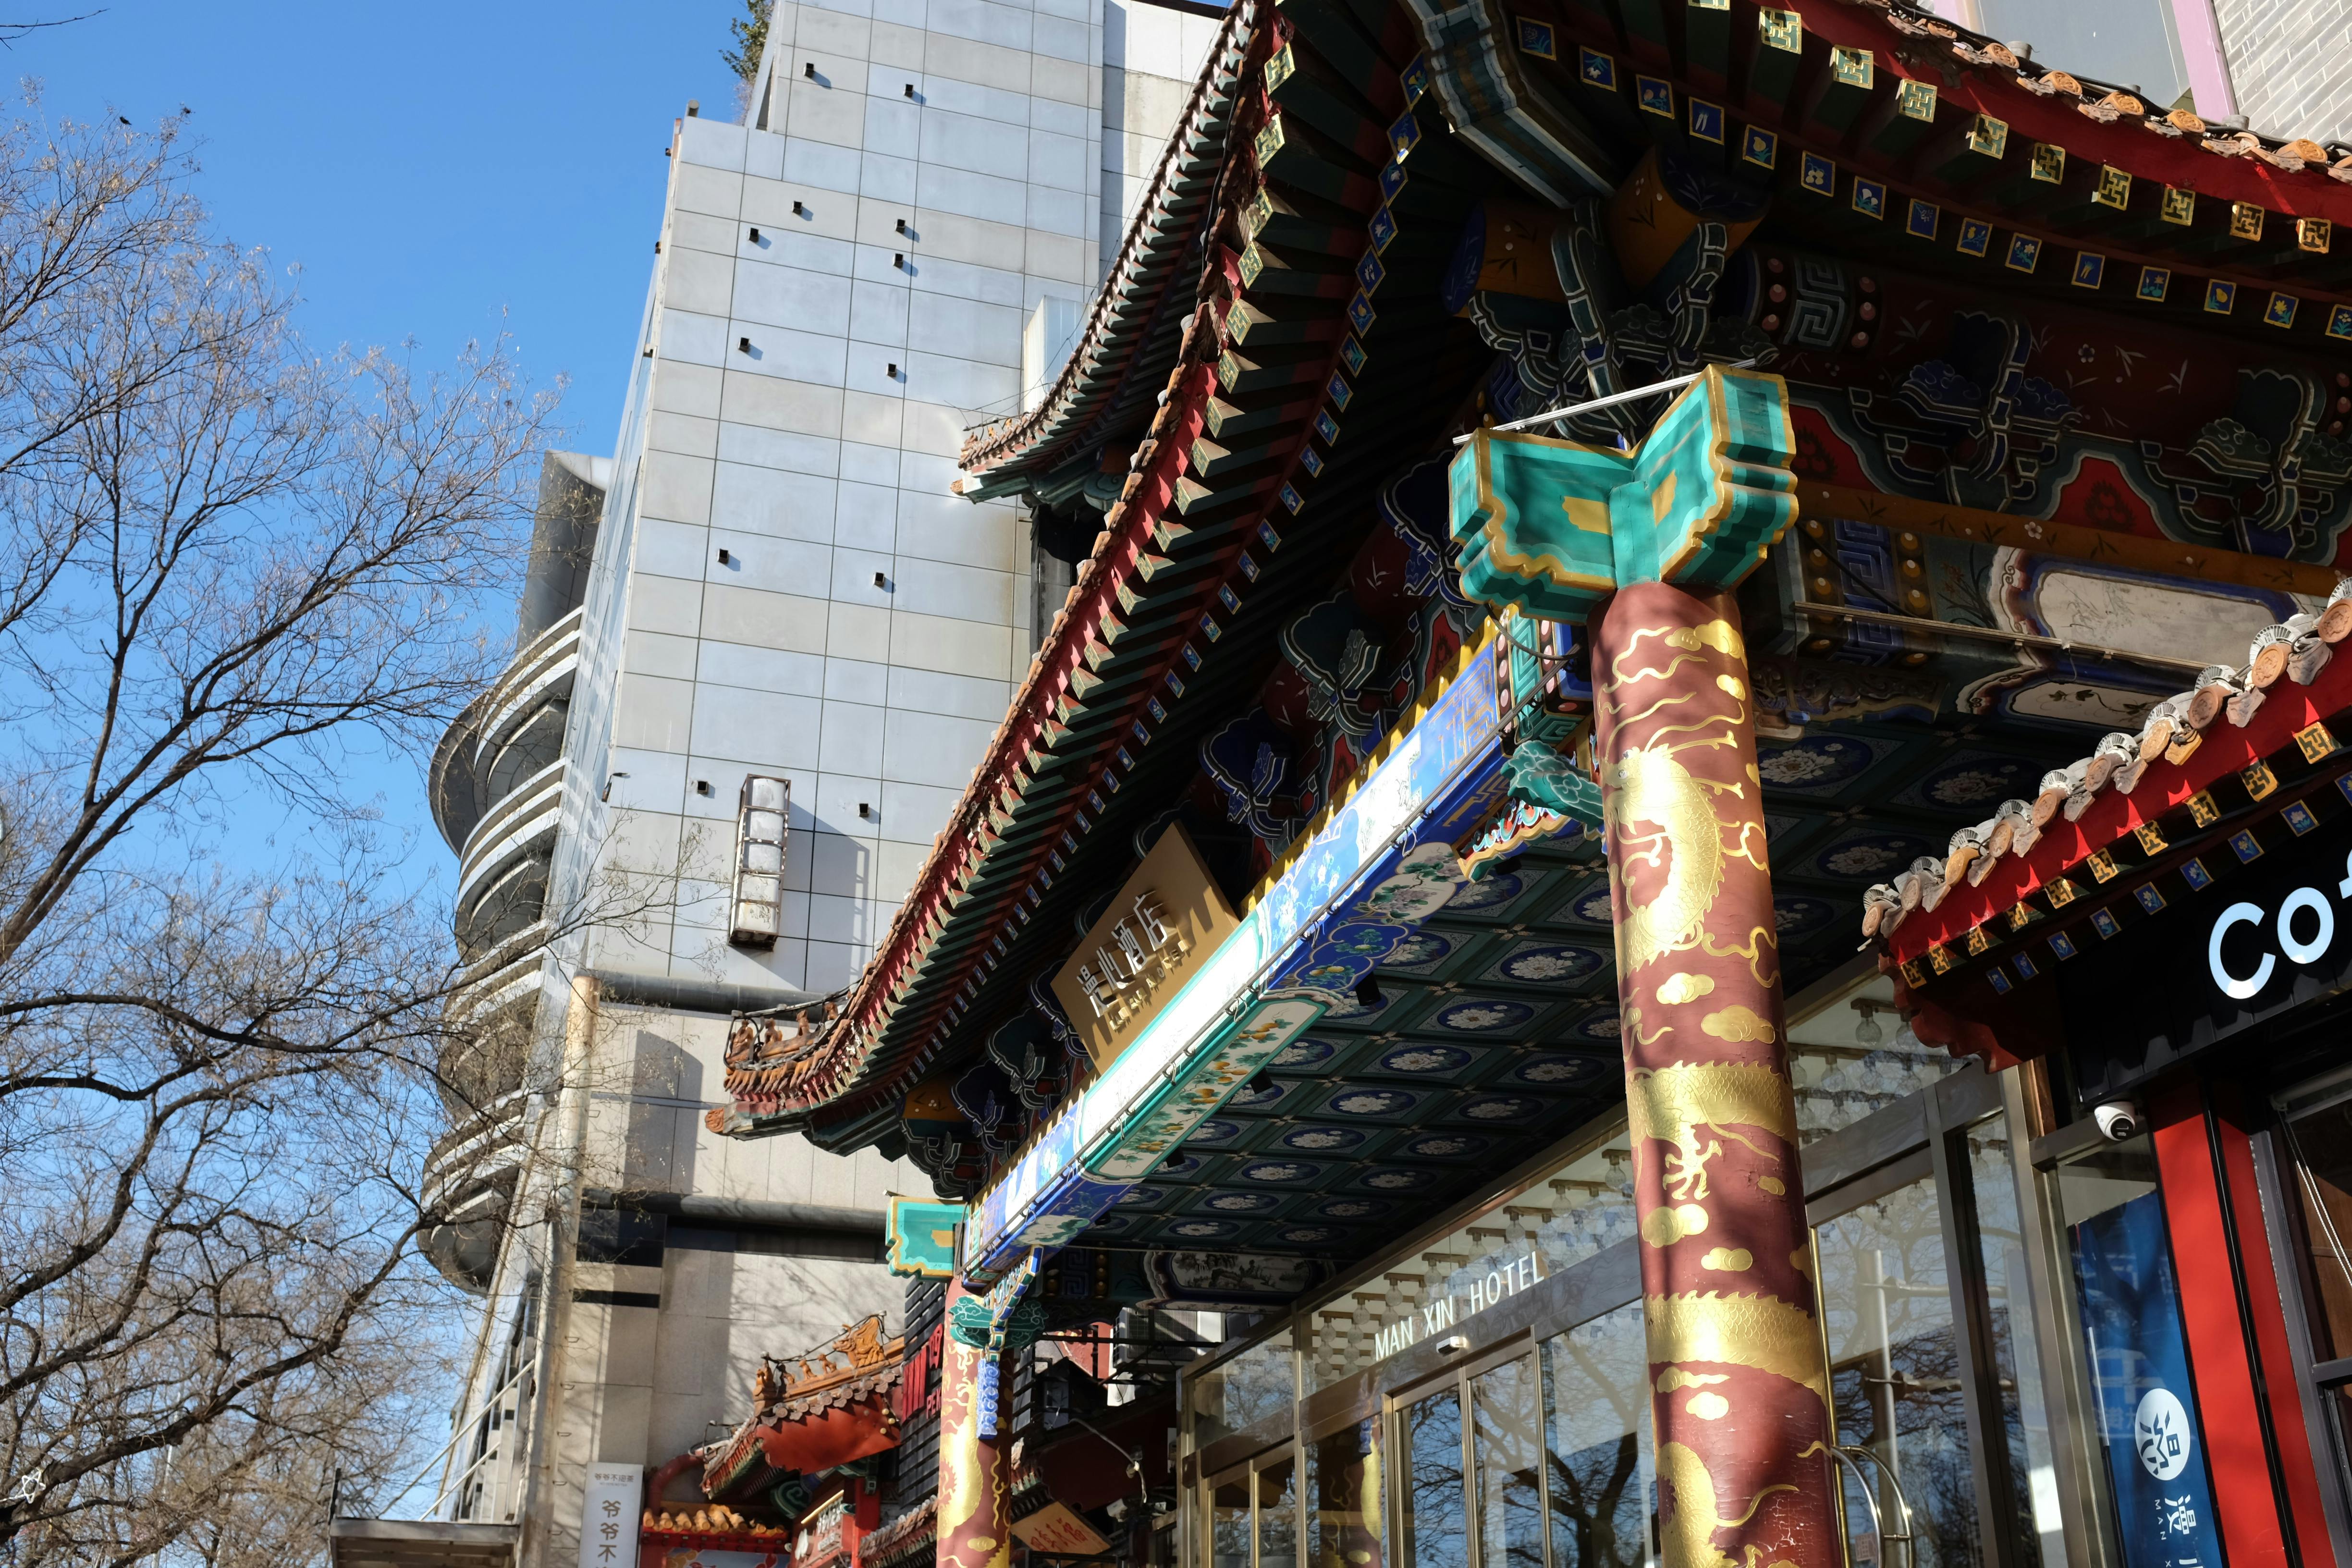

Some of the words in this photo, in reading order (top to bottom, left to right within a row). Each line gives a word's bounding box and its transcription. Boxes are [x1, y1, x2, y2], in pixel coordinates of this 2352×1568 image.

[1077, 891, 1168, 1017] 漫心酒店
[1375, 1316, 1413, 1361] MAN
[1423, 1295, 1454, 1337] XIN
[1470, 1251, 1545, 1314] HOTEL
[596, 1500, 621, 1568] 爷爷不
[2154, 1499, 2167, 1541] MAN
